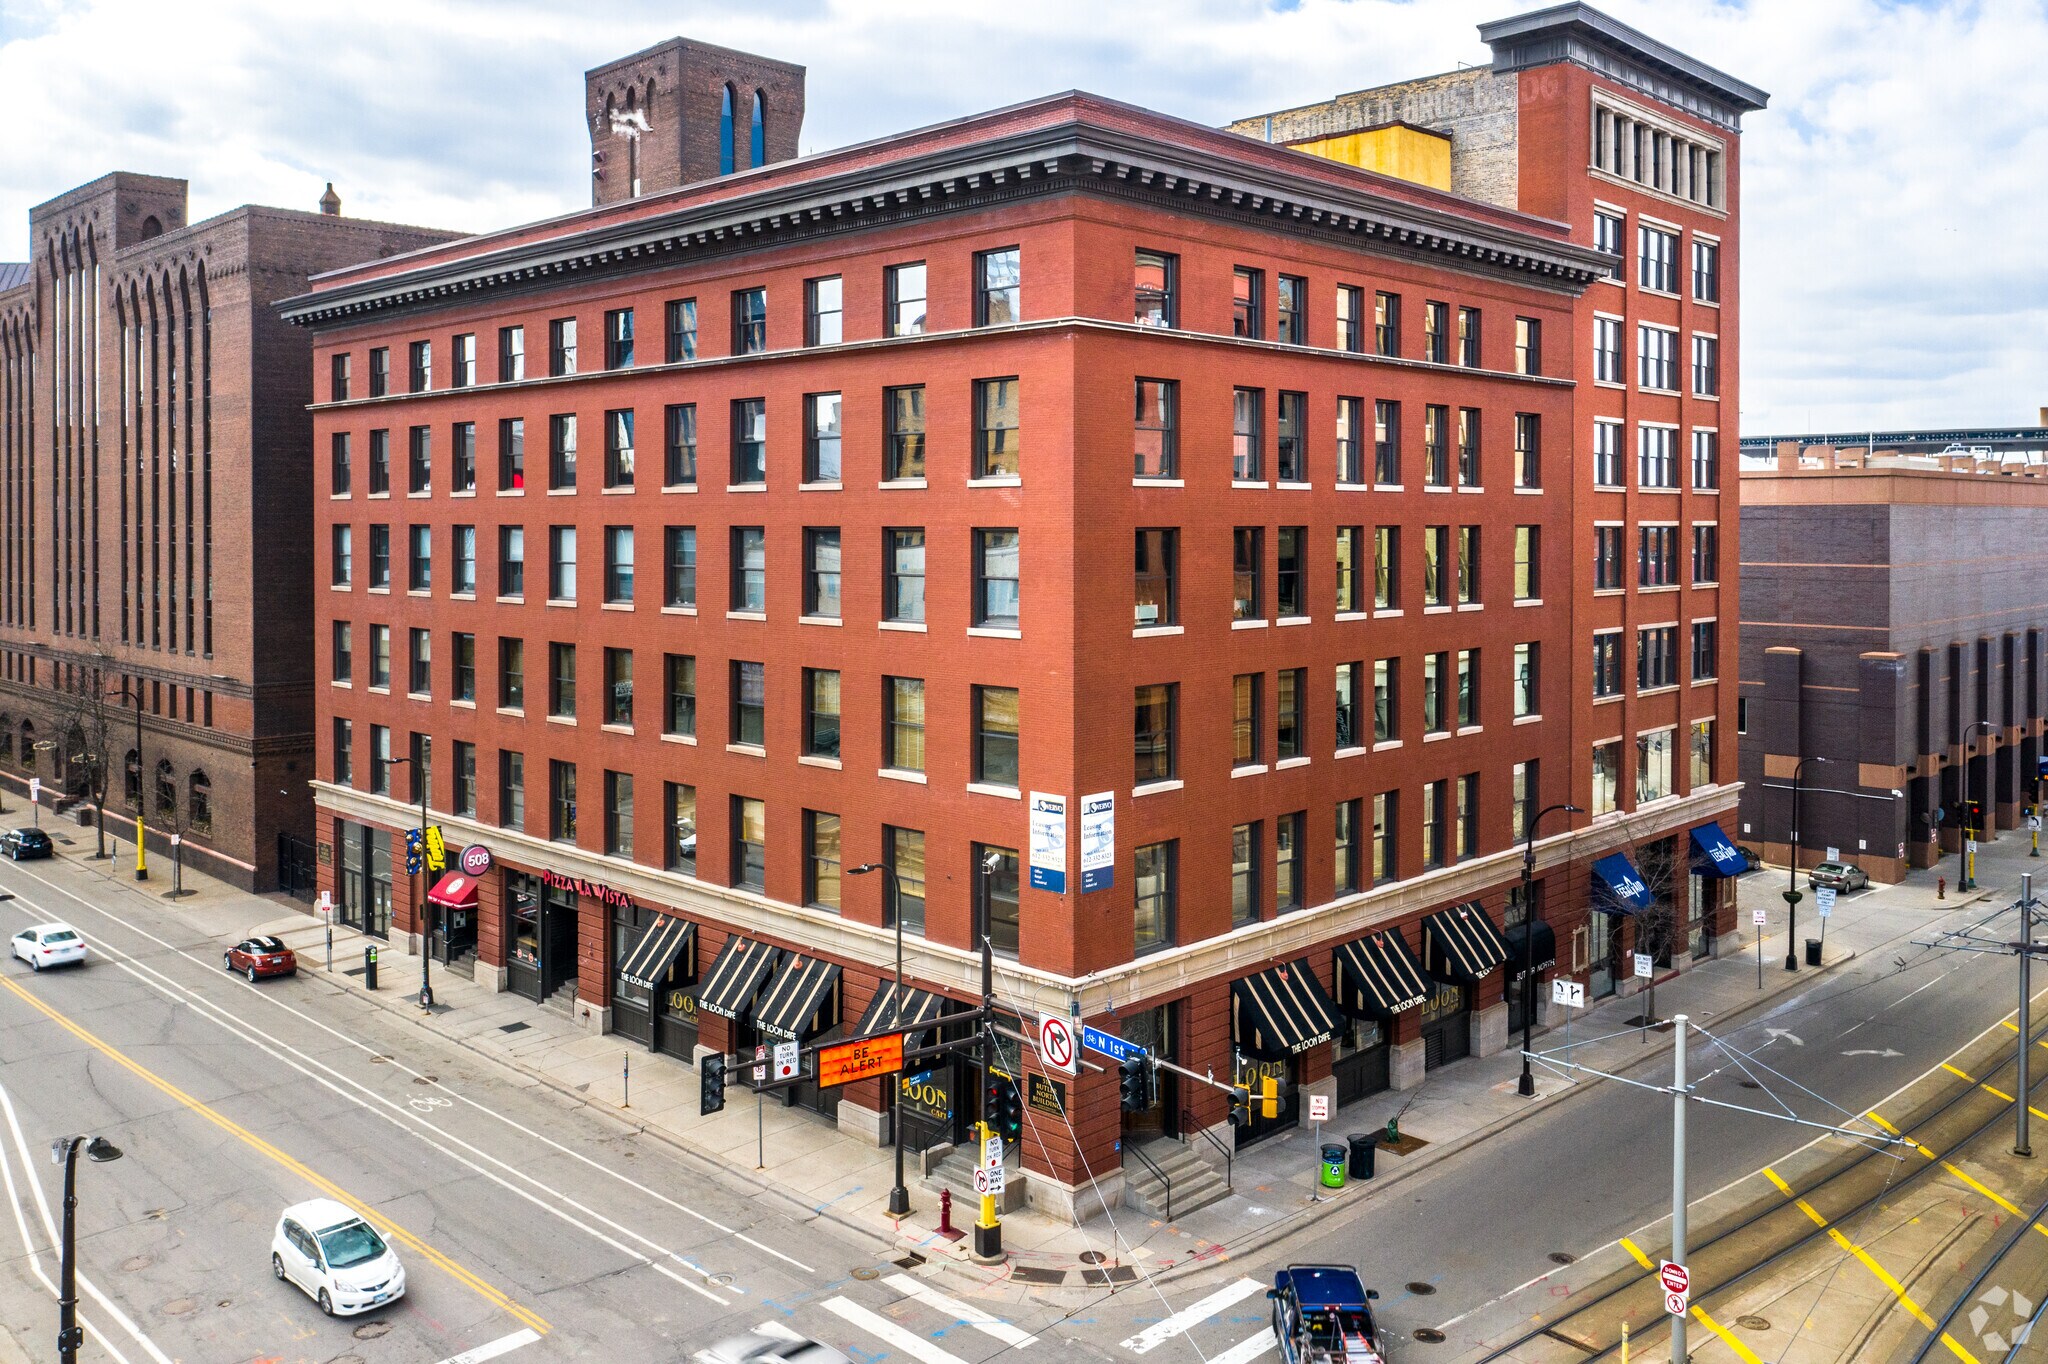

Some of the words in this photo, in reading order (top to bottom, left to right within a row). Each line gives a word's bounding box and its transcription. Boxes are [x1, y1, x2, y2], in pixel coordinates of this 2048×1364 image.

[1091, 802, 1112, 813] SWERVO
[1084, 829, 1112, 839] Information
[468, 852, 490, 867] 508
[543, 869, 574, 892] PIZZA
[579, 879, 592, 897] LA
[597, 884, 628, 908] VISTA
[621, 972, 629, 982] THE
[630, 975, 643, 987] LOON
[1516, 966, 1536, 981] BUTER
[699, 999, 708, 1009] THE
[708, 1002, 723, 1016] LOON
[1390, 1004, 1401, 1015] THE
[1399, 999, 1415, 1011] LOON
[757, 1020, 766, 1031] THE
[767, 1024, 783, 1037] LOON
[1098, 1036, 1105, 1050] N
[1110, 1041, 1125, 1057] 1st
[1291, 1044, 1301, 1054] THE
[1301, 1036, 1318, 1050] LOON
[779, 1051, 794, 1059] TURN
[854, 1047, 869, 1060] BE
[840, 1056, 882, 1075] ALERT
[990, 1169, 1002, 1177] ONE
[990, 1176, 1002, 1184] WAY
[1672, 1269, 1684, 1277] NOT
[1667, 1280, 1683, 1289] ENTER
